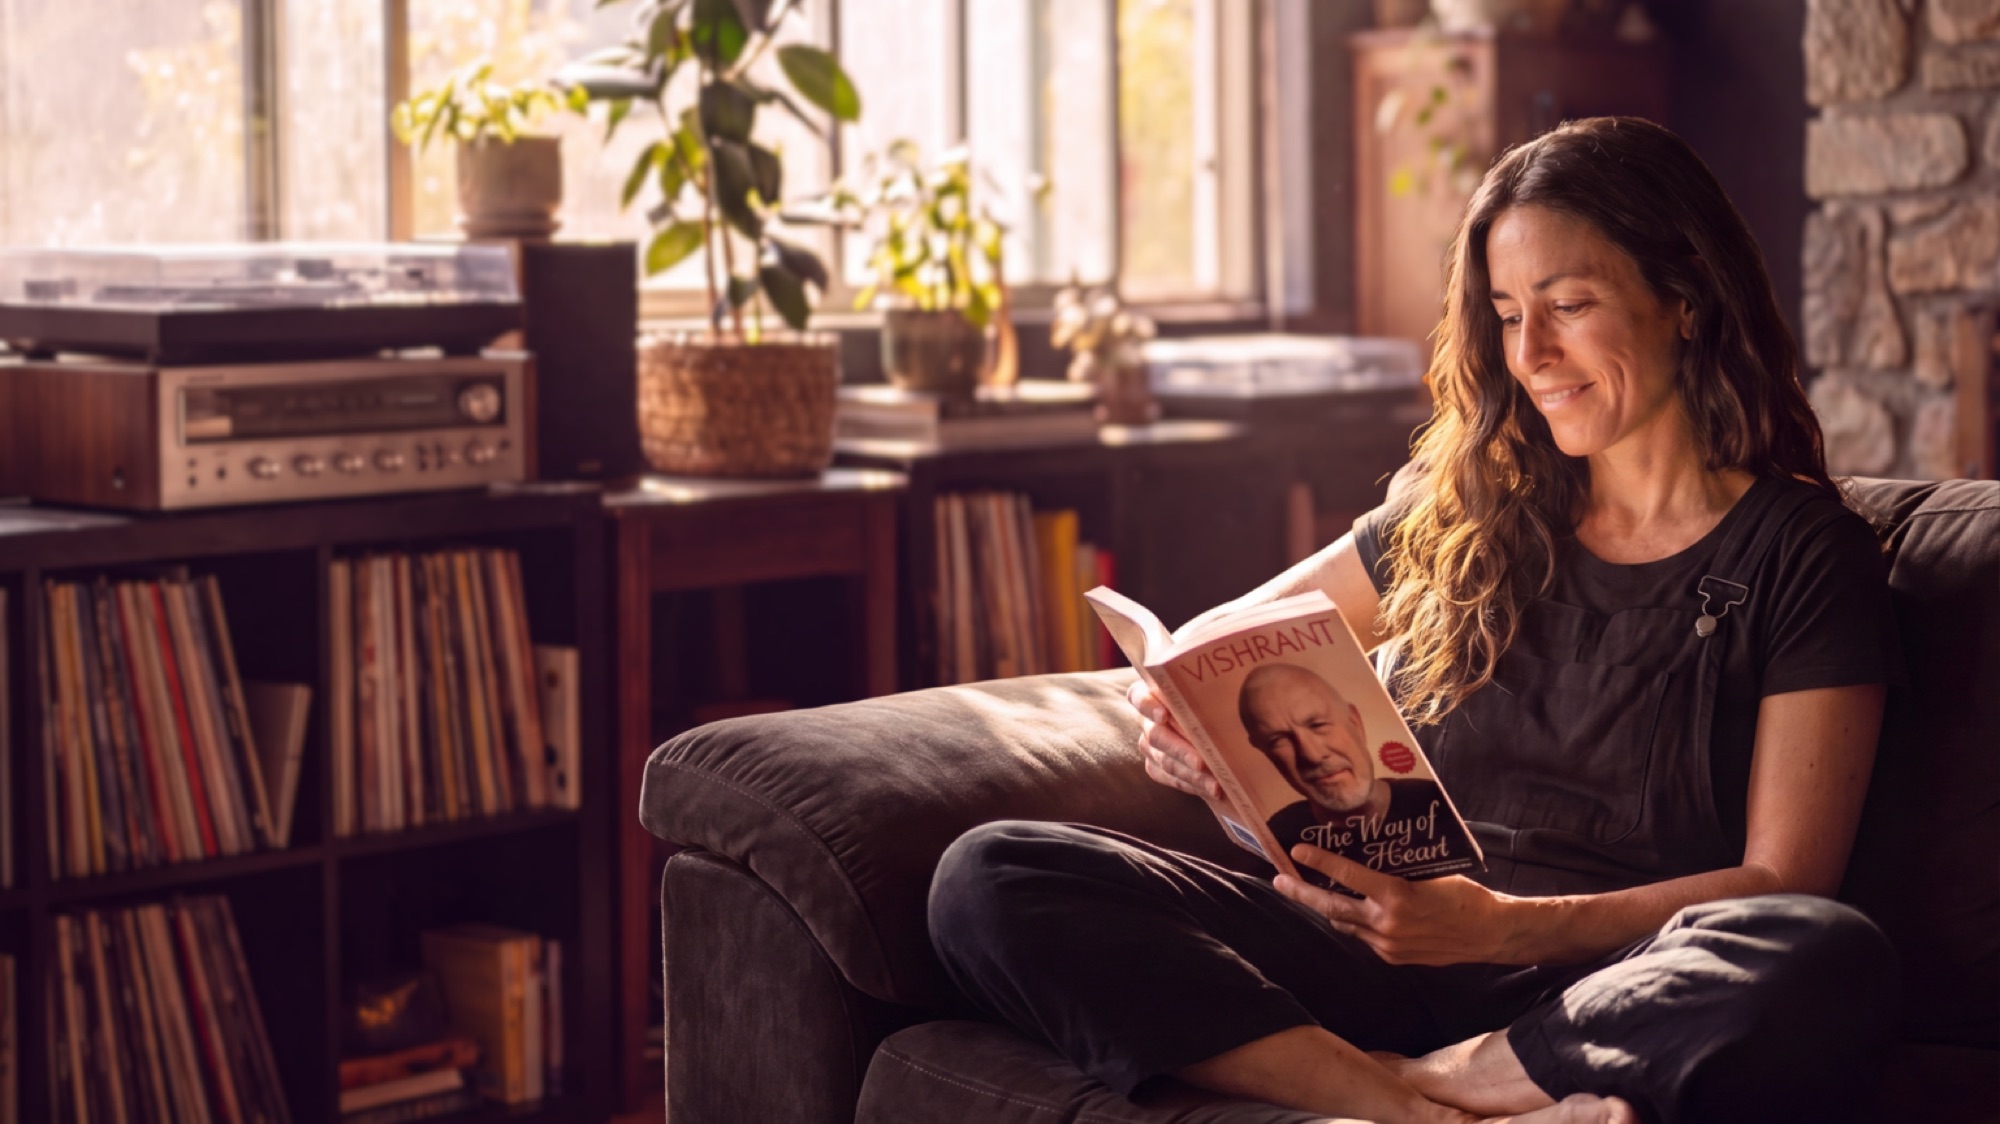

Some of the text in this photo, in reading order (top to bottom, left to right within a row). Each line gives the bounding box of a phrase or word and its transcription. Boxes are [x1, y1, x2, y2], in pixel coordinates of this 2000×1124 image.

[1180, 618, 1335, 683] VISHRANT
[1301, 821, 1353, 850] The
[1345, 812, 1412, 844] Way
[1416, 800, 1440, 840] of
[1363, 835, 1449, 871] Heart
